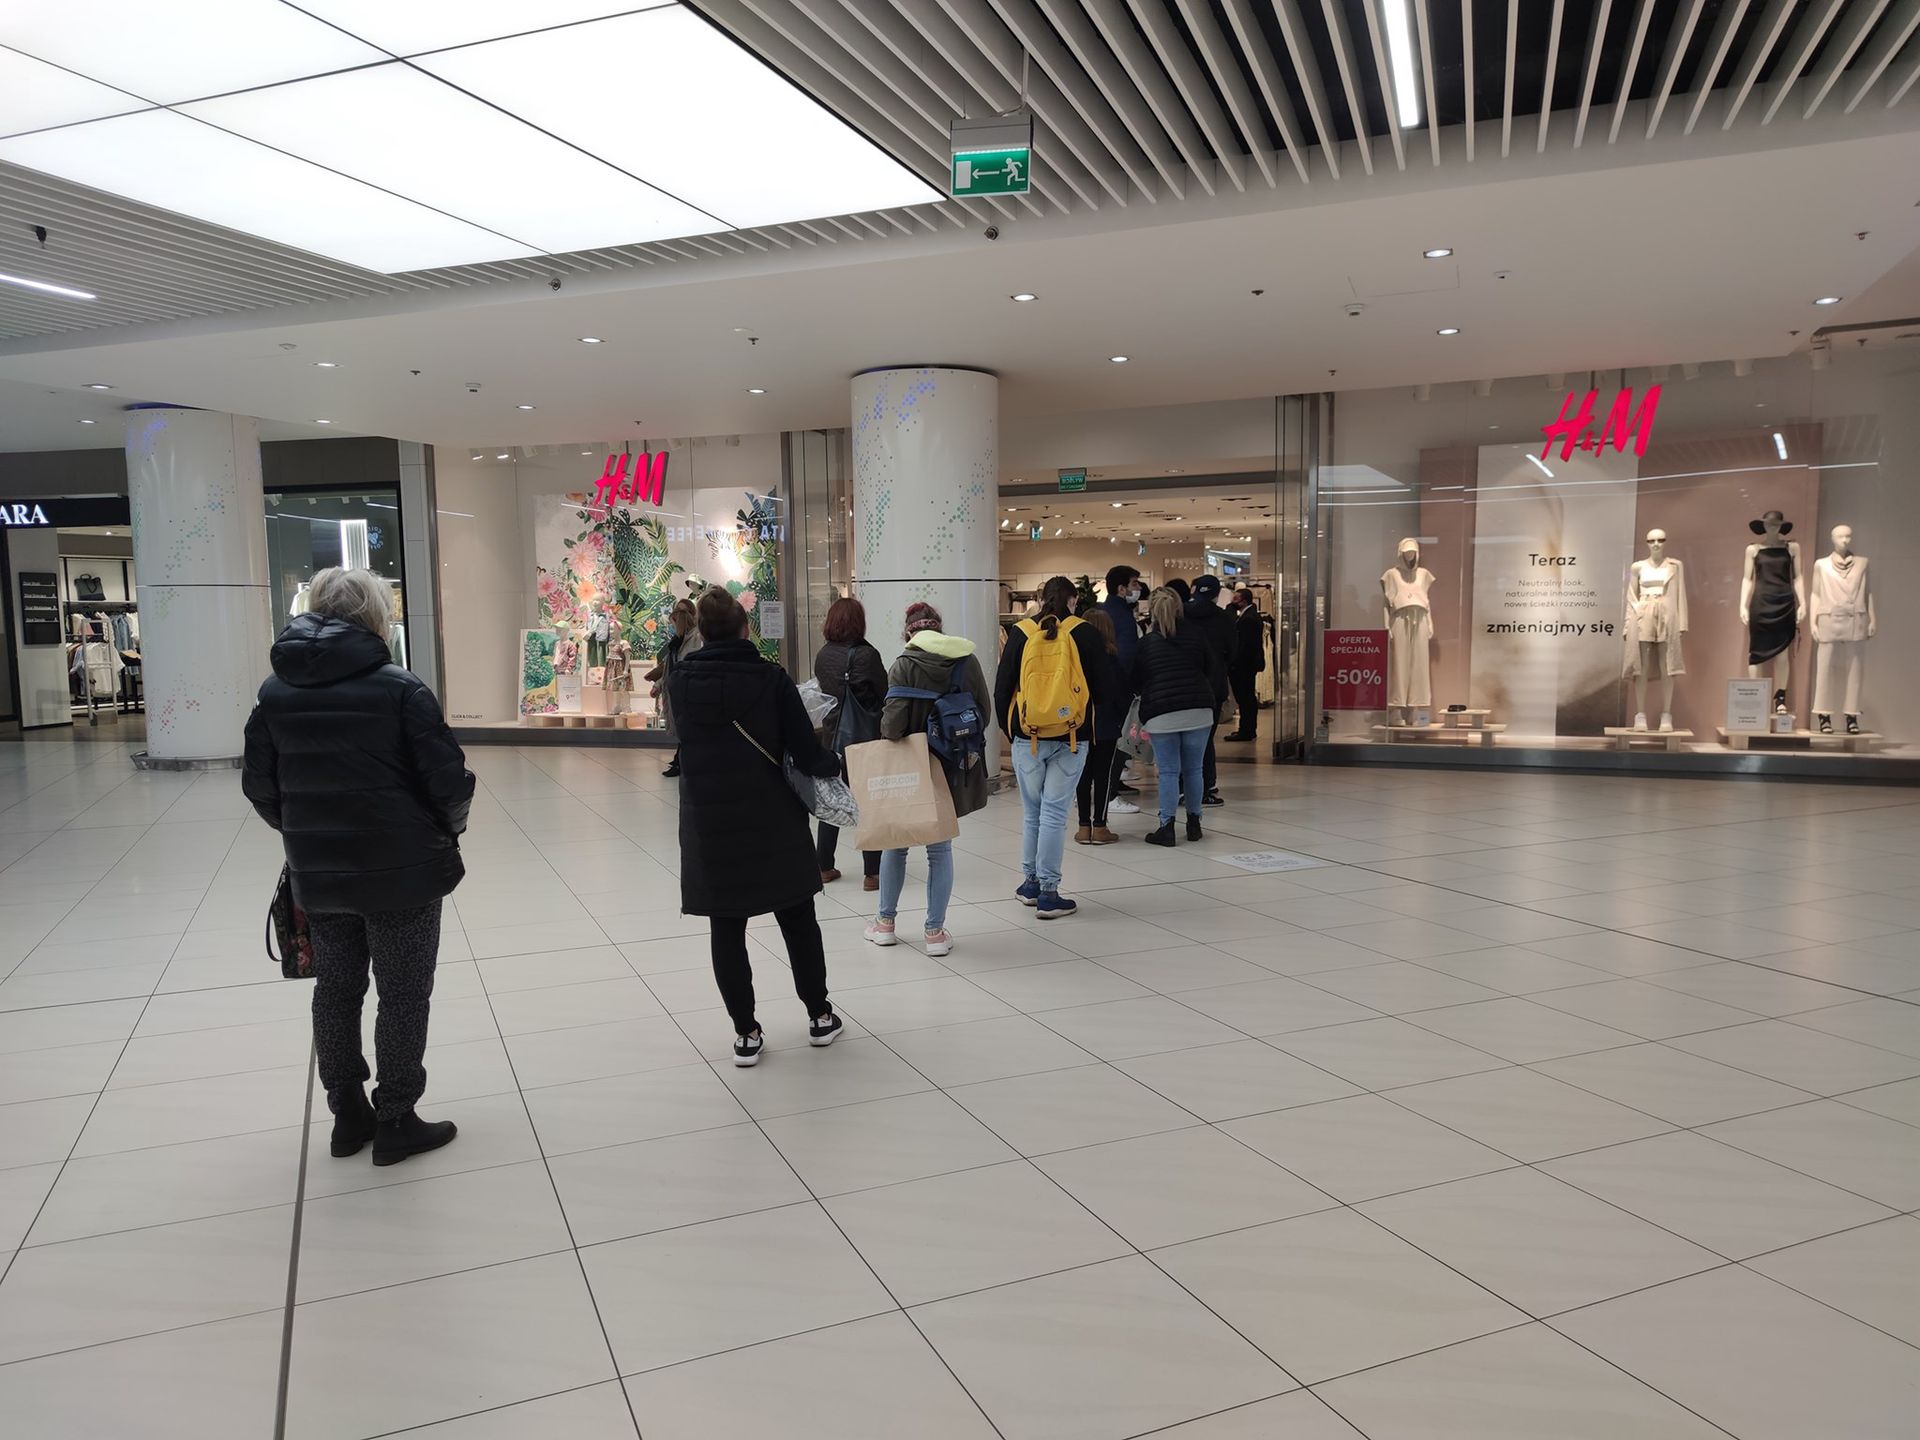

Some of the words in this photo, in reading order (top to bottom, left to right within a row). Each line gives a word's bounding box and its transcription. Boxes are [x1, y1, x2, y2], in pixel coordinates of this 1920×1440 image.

[1540, 384, 1662, 462] H&M
[594, 450, 668, 507] H&M
[1528, 553, 1576, 566] Teraz
[1518, 580, 1561, 589] Neutralny
[1505, 590, 1548, 598] naturalne
[1487, 621, 1586, 636] zmieniajmy
[1590, 620, 1614, 636] się
[1339, 636, 1372, 644] OFERTA
[1330, 646, 1381, 654] SPECJALNA
[1328, 669, 1382, 685] -50%
